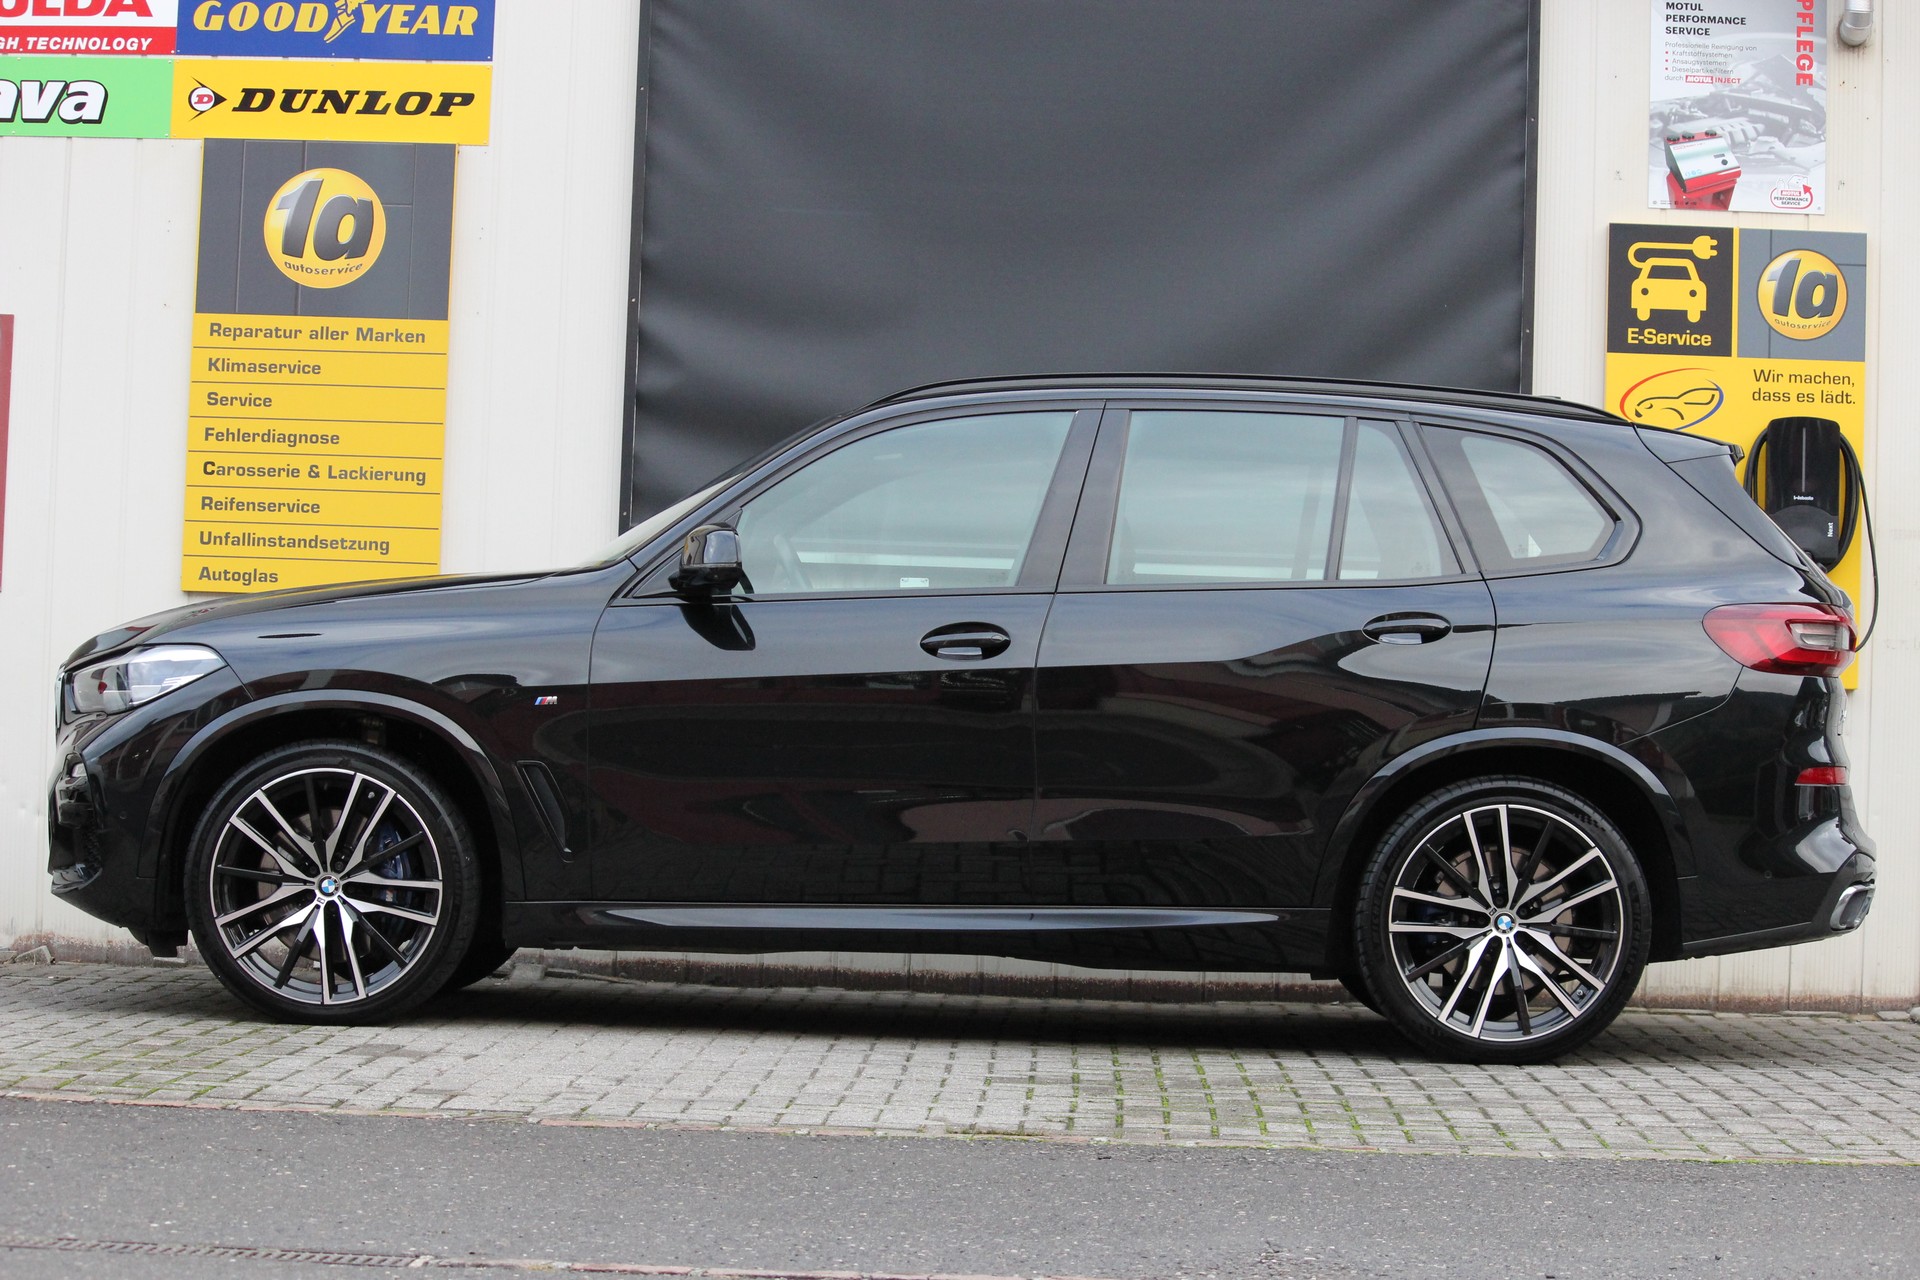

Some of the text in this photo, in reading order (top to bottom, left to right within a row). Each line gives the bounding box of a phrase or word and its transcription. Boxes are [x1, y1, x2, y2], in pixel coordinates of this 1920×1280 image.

[1665, 2, 1704, 11] MOTUL
[1665, 14, 1747, 26] PERFORMANCE
[1665, 26, 1711, 36] SERVICE
[26, 37, 153, 51] TECHNOLOGY
[1664, 41, 1710, 50] Professionelle
[1711, 43, 1744, 52] Reinigung
[1796, 0, 1814, 86] PFLEGE
[1686, 75, 1713, 83] MOTUL
[231, 87, 476, 117] DUNLOP
[275, 178, 375, 262] 1a
[284, 260, 364, 276] autoservice
[1766, 258, 1839, 319] 1a
[209, 322, 426, 344] Reparatur aller Marken
[1774, 318, 1832, 330] autoservice
[1627, 327, 1712, 347] E-Service
[207, 357, 322, 375] Klimaservice
[1753, 368, 1855, 388] Wir machen,
[206, 391, 273, 408] Service
[1752, 387, 1856, 405] dass es lädt.
[204, 427, 340, 448] Fehlerdiagnose
[203, 461, 426, 487] Carosserie & Lackierung
[201, 496, 321, 514] Reifenservice
[199, 531, 390, 556] Unfallinstandsetzung
[198, 566, 279, 586] Autoglas
